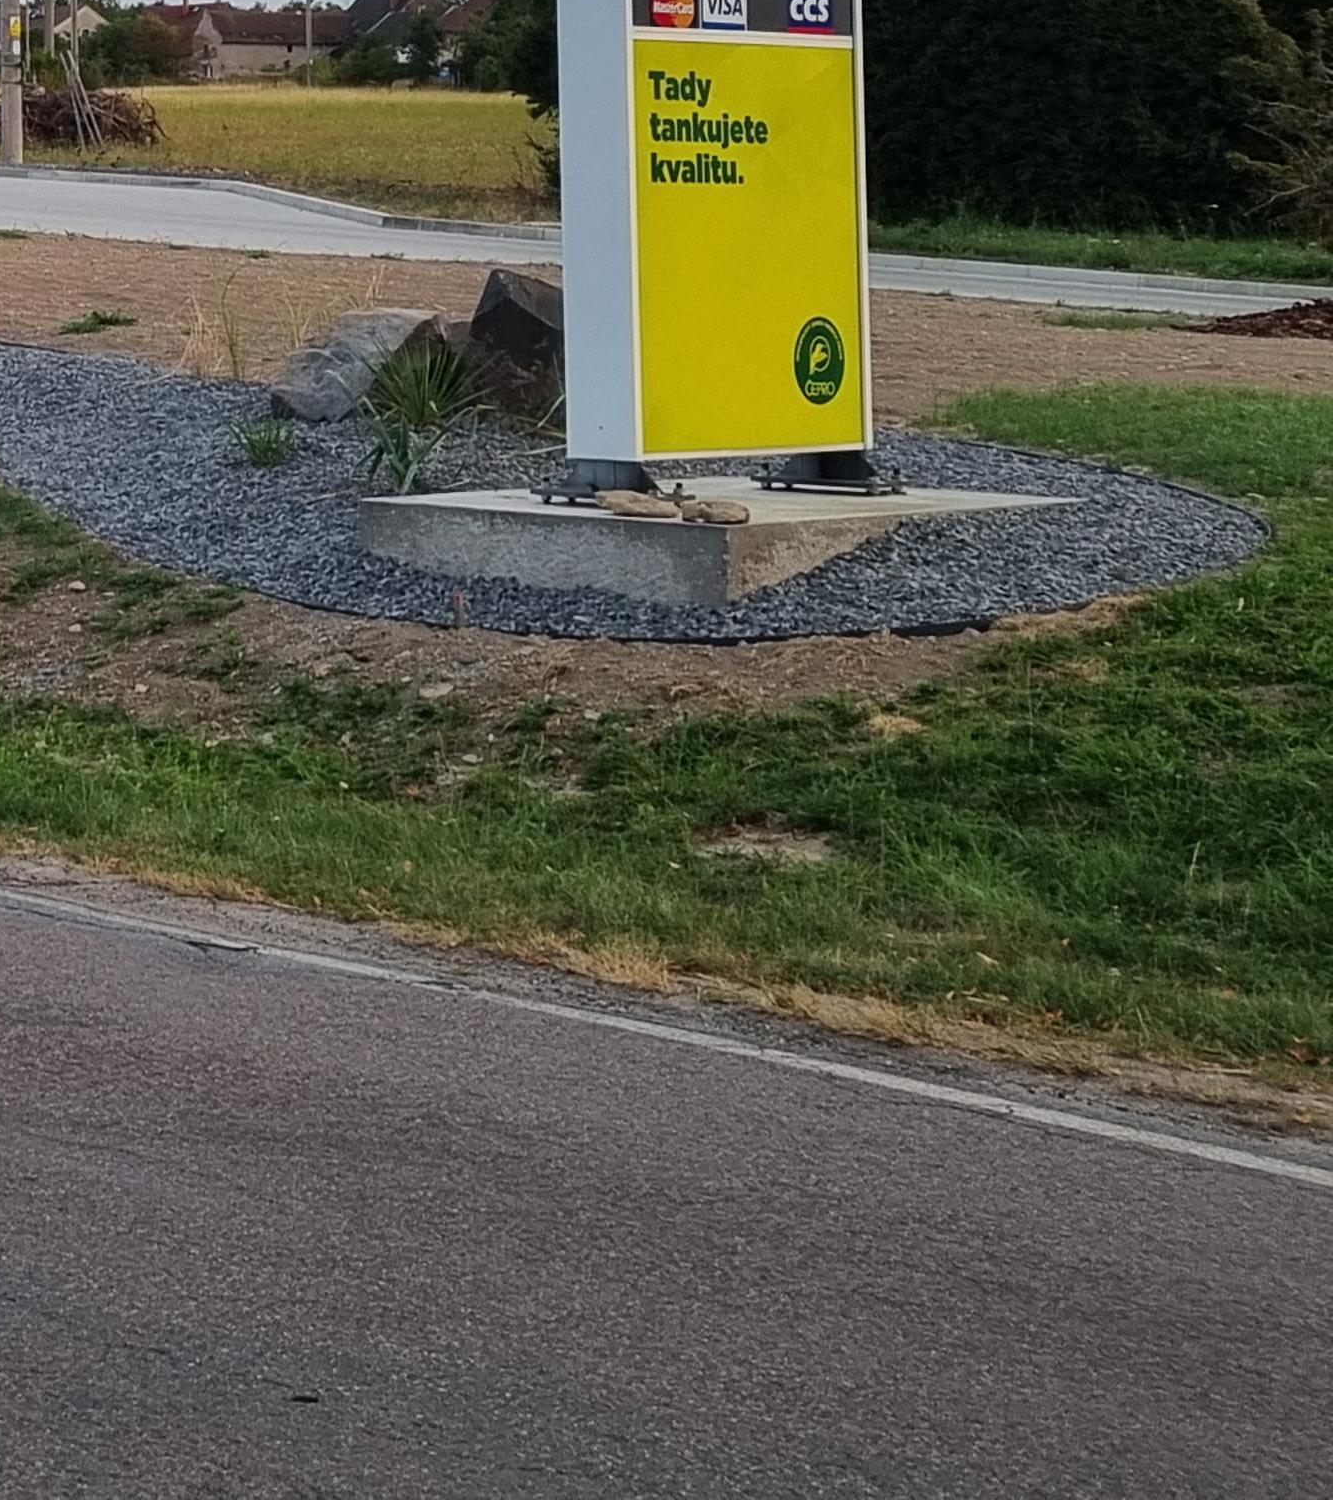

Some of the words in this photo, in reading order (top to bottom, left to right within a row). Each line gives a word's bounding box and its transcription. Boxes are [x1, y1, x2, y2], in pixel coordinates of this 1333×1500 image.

[648, 70, 712, 108] Tady
[649, 112, 769, 149] tankujete
[650, 152, 745, 185] kvalitu.
